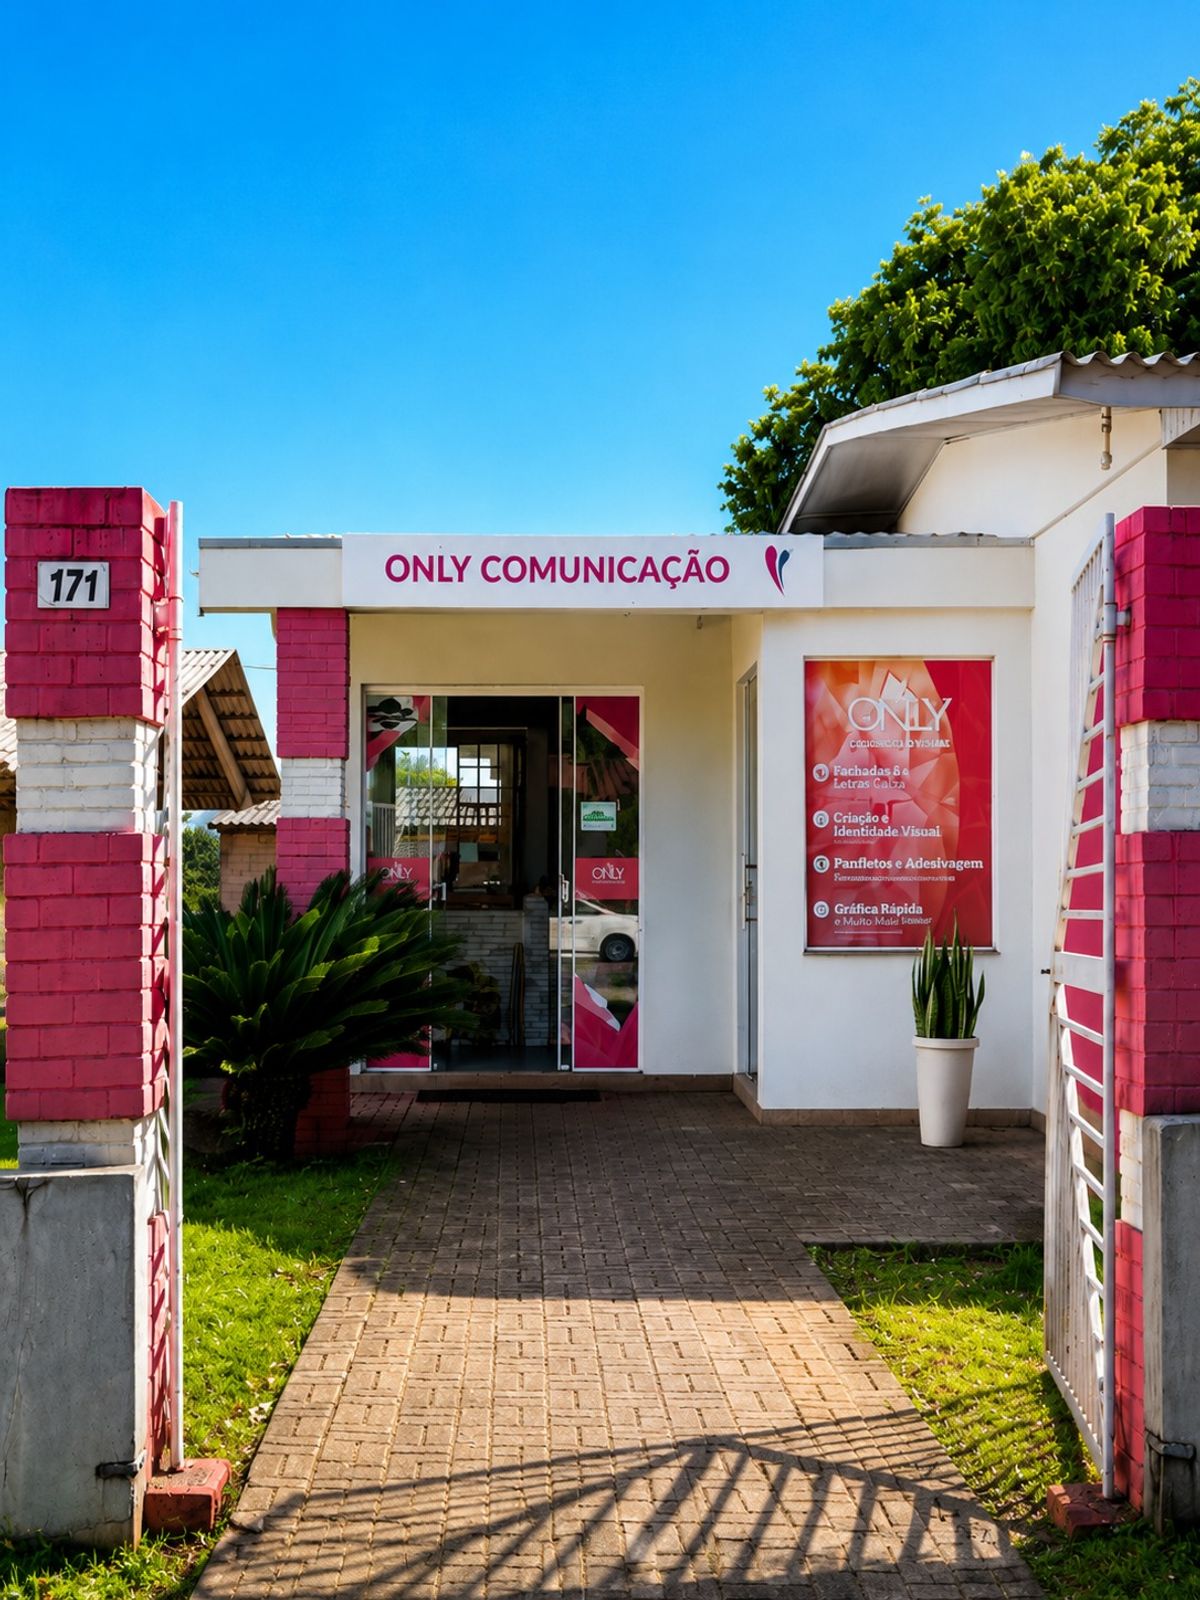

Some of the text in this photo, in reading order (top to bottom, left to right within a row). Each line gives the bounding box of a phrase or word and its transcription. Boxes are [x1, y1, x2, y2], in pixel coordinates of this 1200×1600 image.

[385, 549, 730, 589] ONLY COMUNICAÇÃO
[50, 568, 98, 602] 171
[848, 697, 952, 732] ONLY
[833, 765, 891, 776] Fachadas
[833, 778, 870, 789] Letras
[833, 812, 889, 825] Criação e
[833, 826, 899, 837] Identidade
[833, 857, 983, 871] Panfletos e Adesivagem
[591, 866, 625, 880] ONLY
[834, 903, 923, 916] Gráfica Rápida
